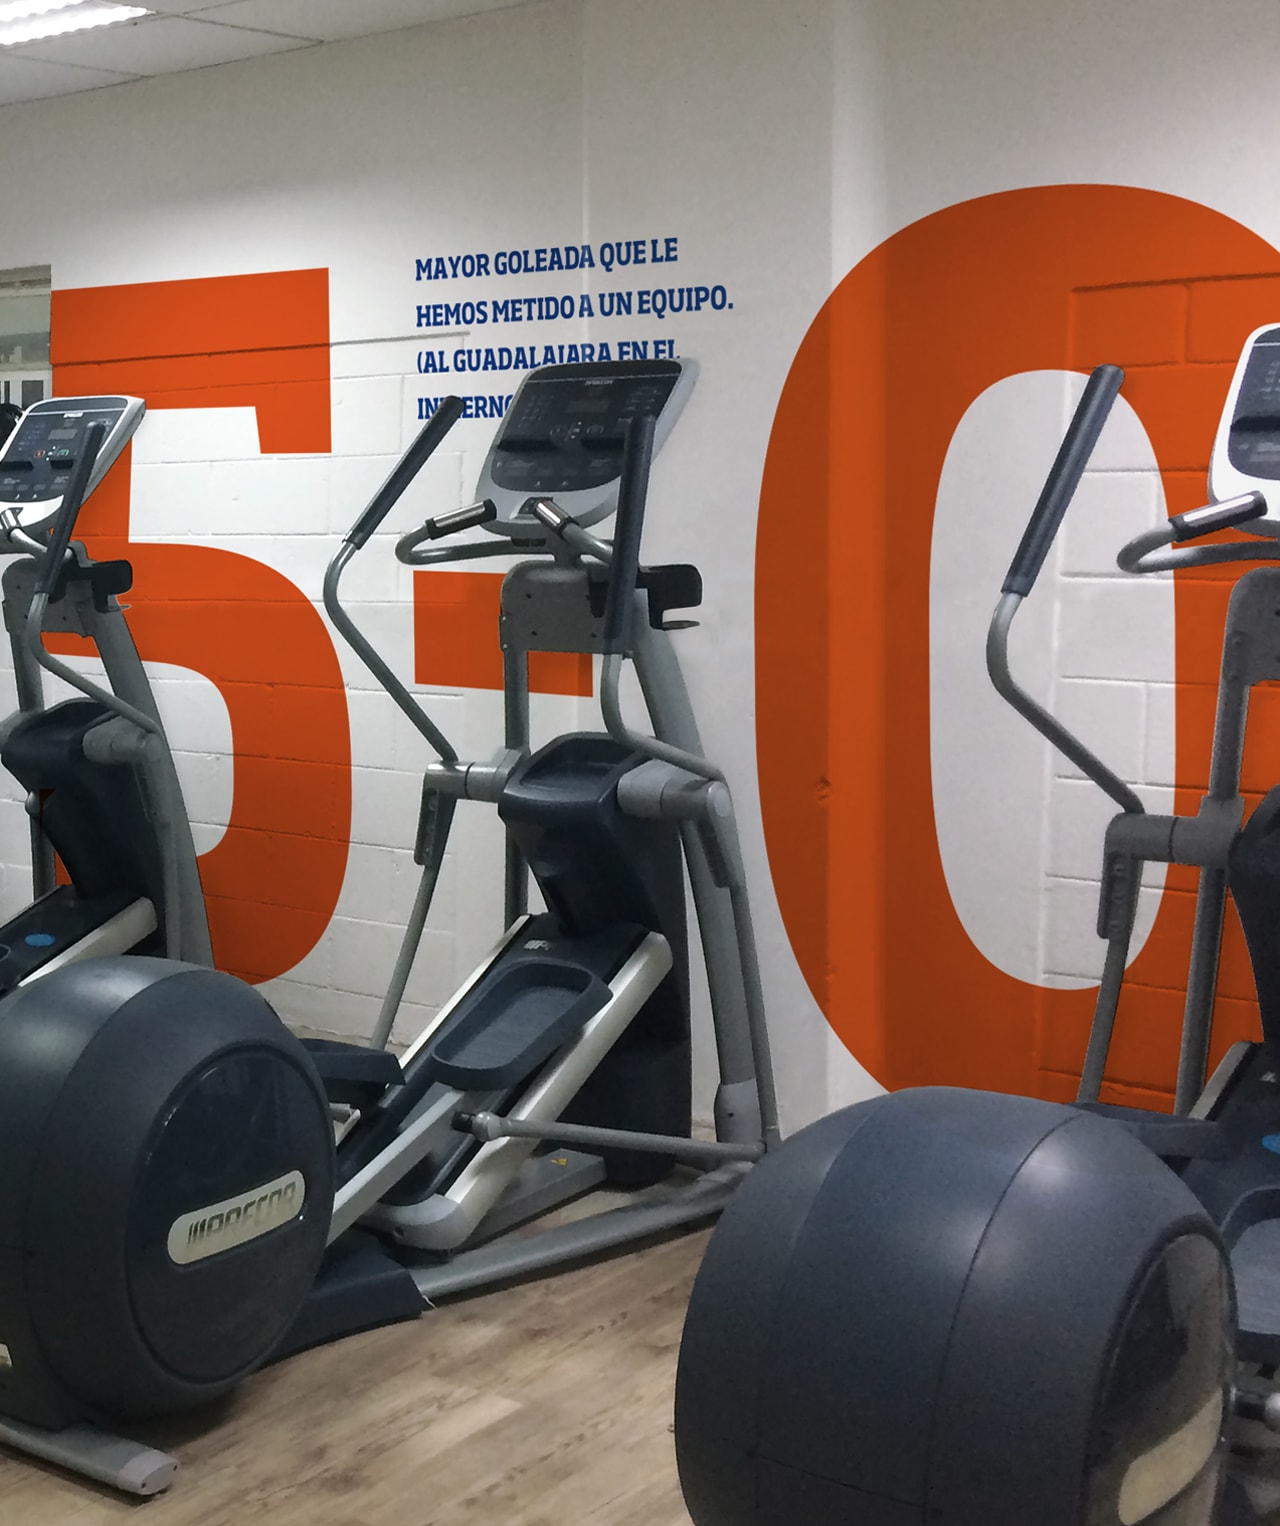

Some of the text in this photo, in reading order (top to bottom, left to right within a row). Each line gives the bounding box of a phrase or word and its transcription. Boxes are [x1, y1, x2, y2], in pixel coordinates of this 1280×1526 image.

[415, 237, 678, 281] MAYOR GOLEADA QUE LE
[415, 285, 734, 328] HEMOS METIDO A UN EQUIPO.
[417, 350, 450, 374] (AL
[617, 340, 648, 361] EN
